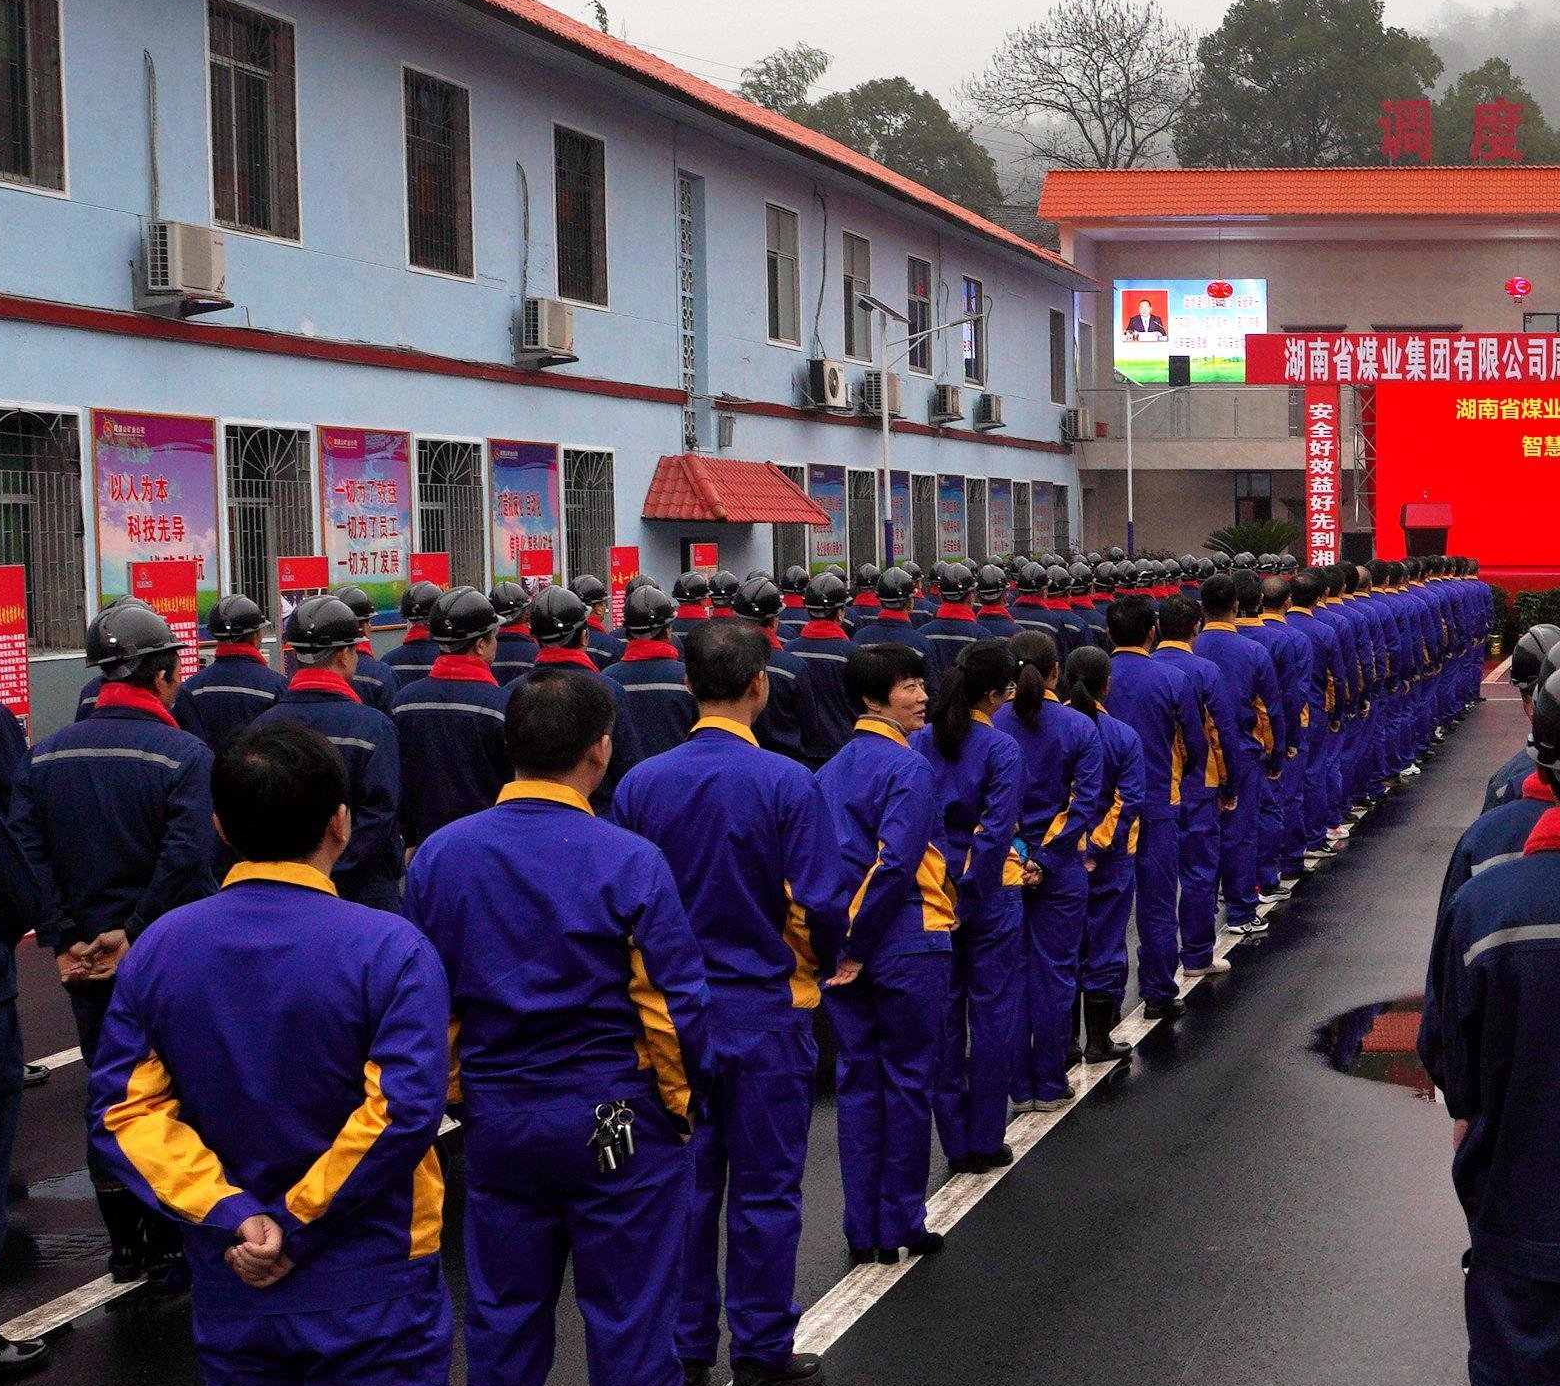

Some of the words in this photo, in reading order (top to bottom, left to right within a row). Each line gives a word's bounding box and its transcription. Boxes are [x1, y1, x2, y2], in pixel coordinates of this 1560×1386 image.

[110, 474, 169, 502] 以人为本
[335, 480, 398, 504] 一切为了效益
[127, 514, 185, 543] 科技先导
[336, 515, 399, 539] 一切为了员工
[337, 550, 400, 575] 一切为了发展
